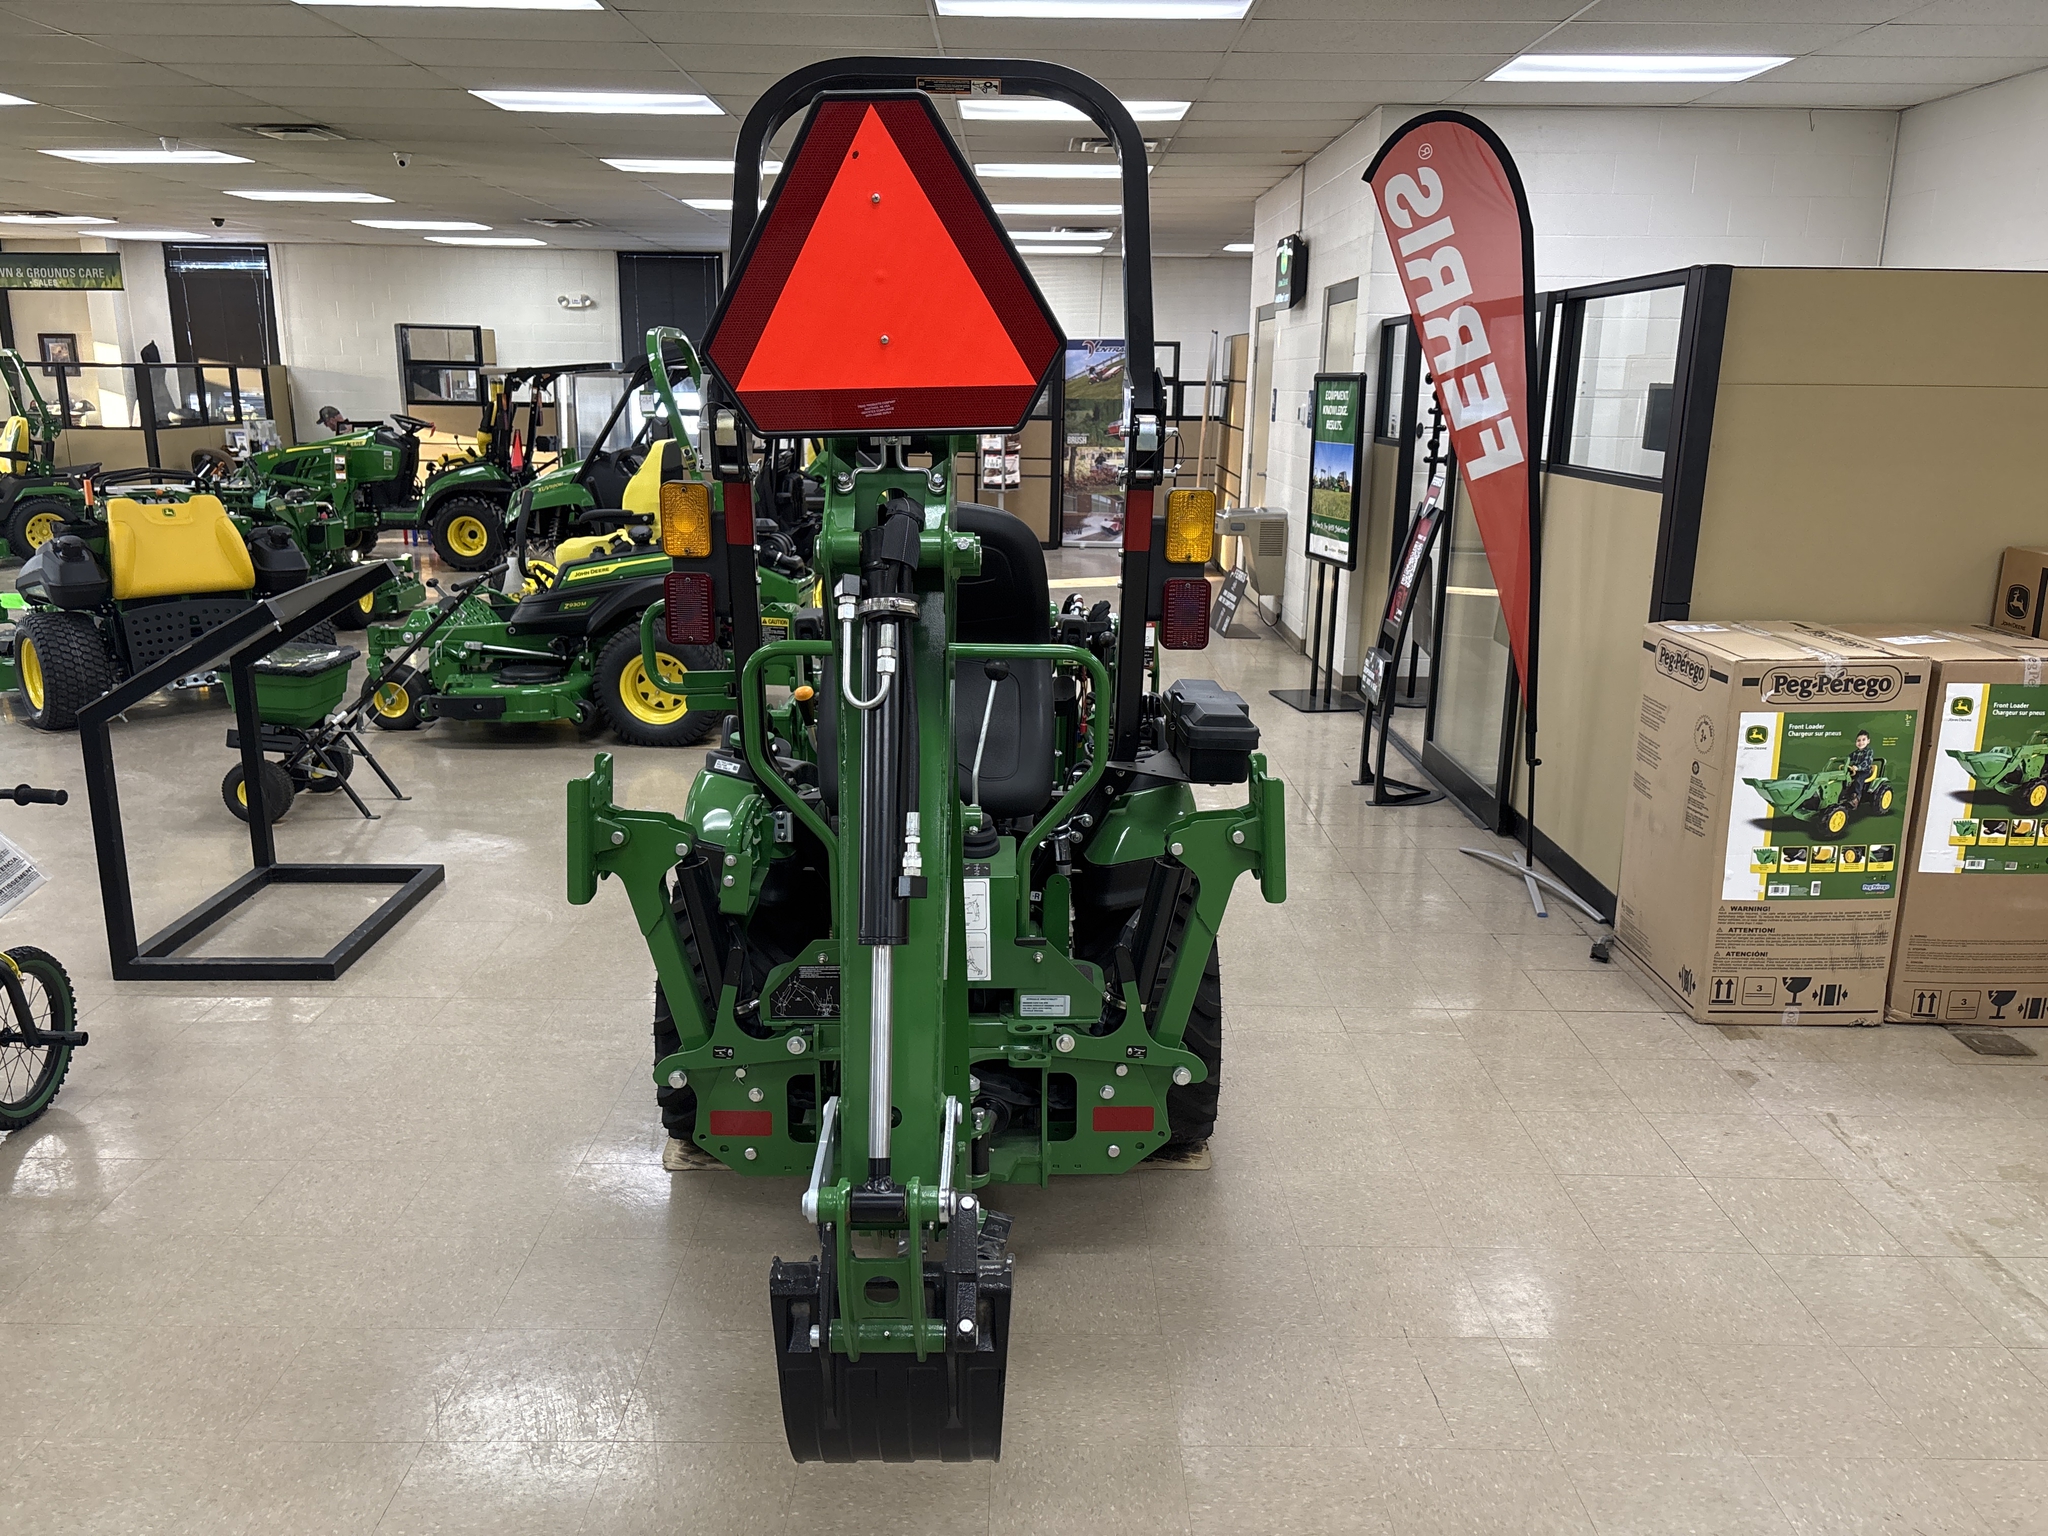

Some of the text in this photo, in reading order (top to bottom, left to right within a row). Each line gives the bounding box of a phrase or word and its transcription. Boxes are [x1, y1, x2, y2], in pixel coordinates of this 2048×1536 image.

[16, 267, 24, 278] &
[26, 267, 76, 278] GROUNDS
[78, 268, 105, 279] CARE
[591, 567, 610, 575] DEERE
[1773, 670, 1893, 699] Peg-Pérego
[1992, 709, 2018, 717] Chargeur
[1788, 730, 1814, 738] Chargeur
